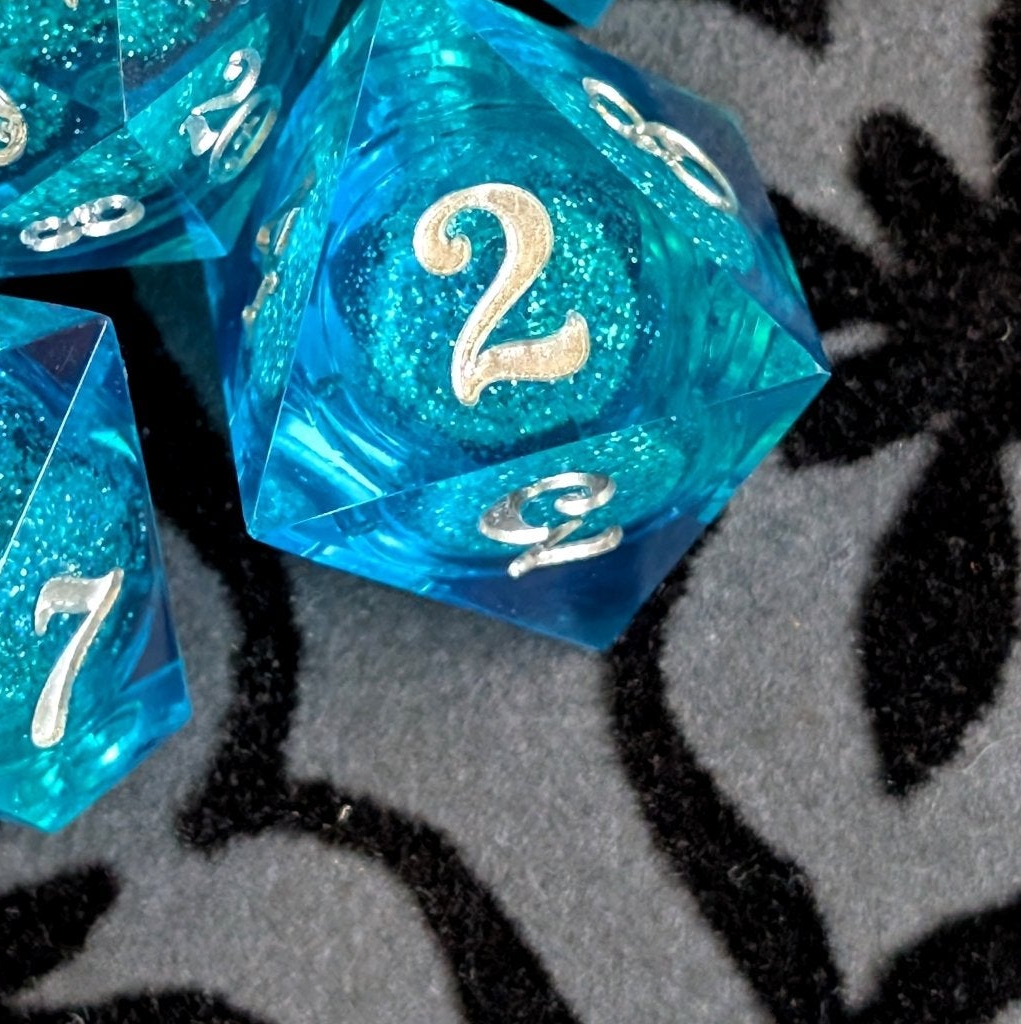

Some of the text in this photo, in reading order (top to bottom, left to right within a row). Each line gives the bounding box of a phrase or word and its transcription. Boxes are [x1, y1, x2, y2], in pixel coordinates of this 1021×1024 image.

[178, 47, 282, 184] 20
[581, 76, 739, 215] 8
[413, 182, 591, 407] 2
[31, 568, 125, 749] 7
